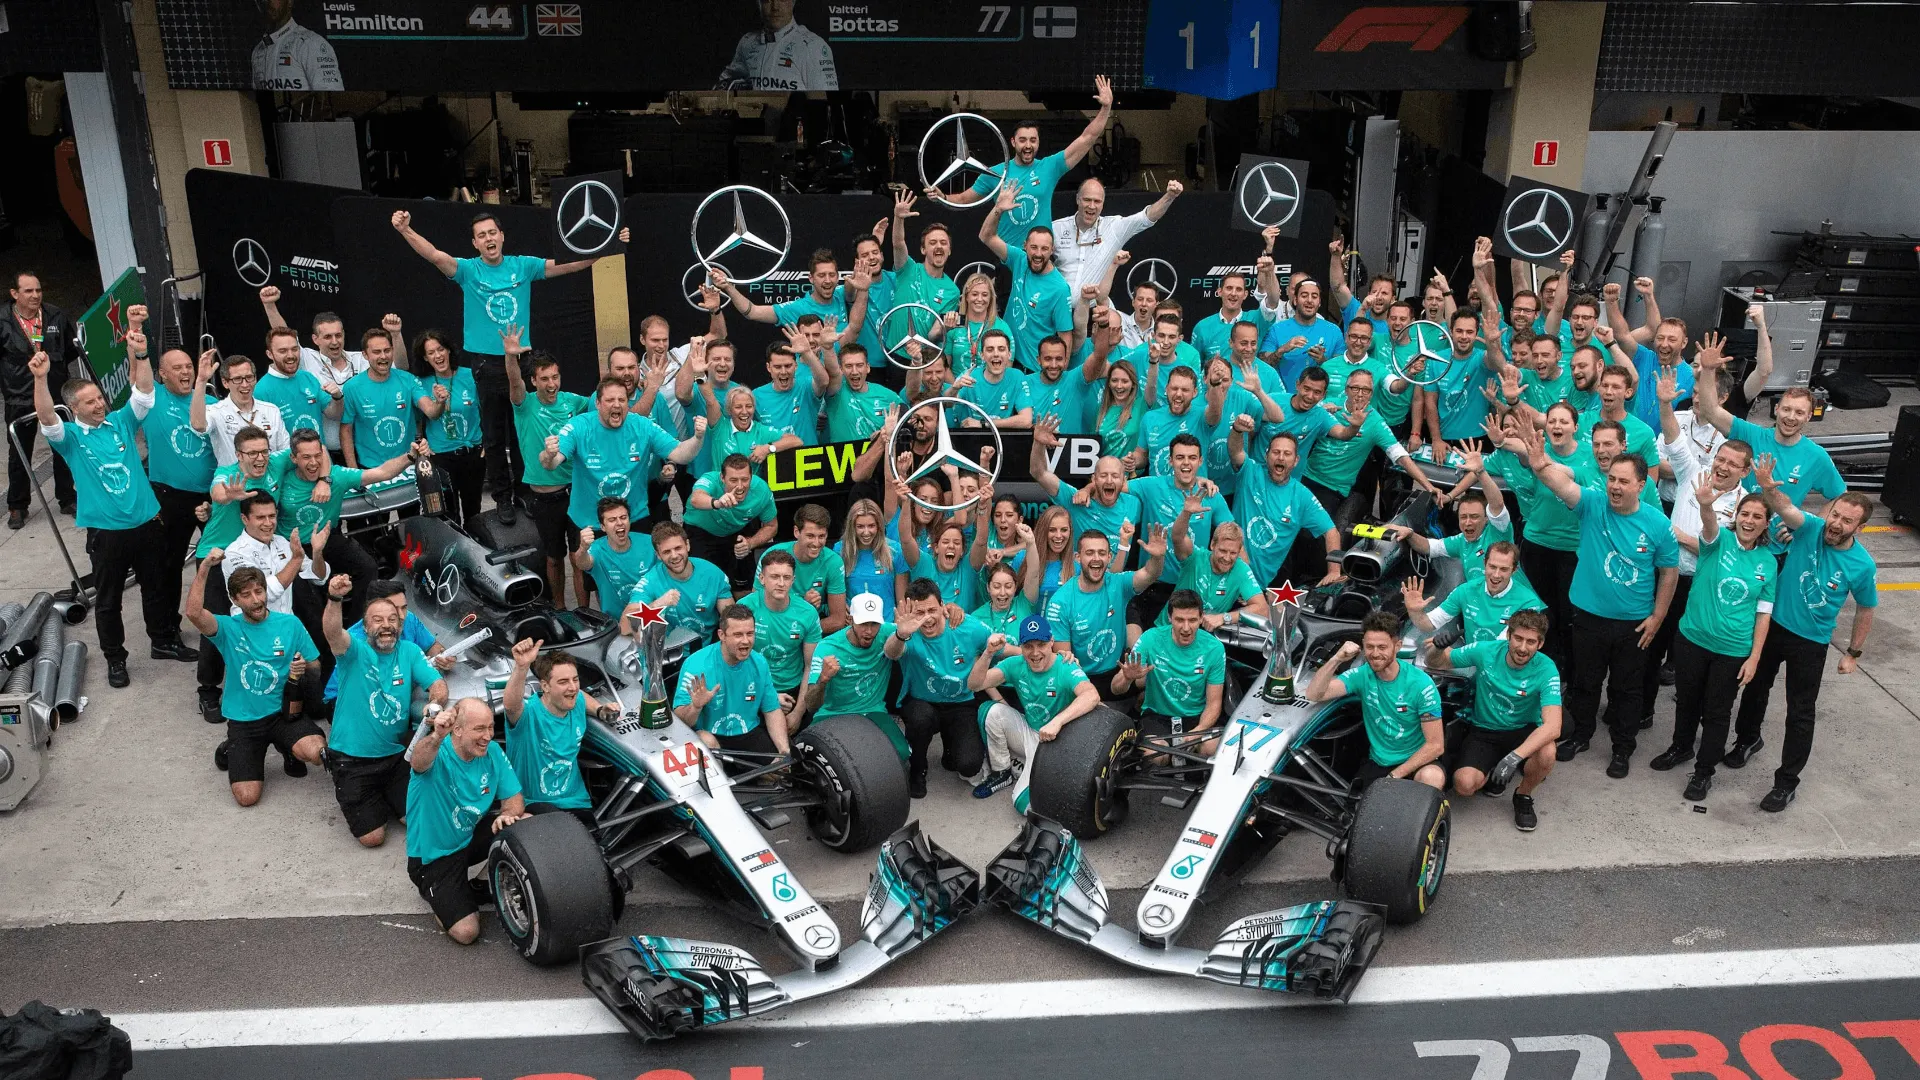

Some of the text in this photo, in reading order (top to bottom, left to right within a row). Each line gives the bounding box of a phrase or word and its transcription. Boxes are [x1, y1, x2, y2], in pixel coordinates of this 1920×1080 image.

[323, 2, 356, 12] Lewis
[829, 5, 869, 14] Valtteri
[325, 14, 424, 31] Hamilton
[468, 7, 513, 29] 44
[829, 16, 899, 32] Bottas
[978, 6, 1011, 33] 77
[1178, 22, 1195, 70] 1
[1250, 21, 1260, 69] 1
[292, 279, 340, 294] MOTORSP
[1225, 719, 1284, 752] 77
[662, 742, 711, 777] 44
[1153, 884, 1189, 900] PIRELLI
[784, 905, 818, 923] PIRELLI
[1244, 914, 1284, 926] PETRONAS
[690, 945, 733, 956] PETRONAS
[626, 977, 647, 1007] IWC
